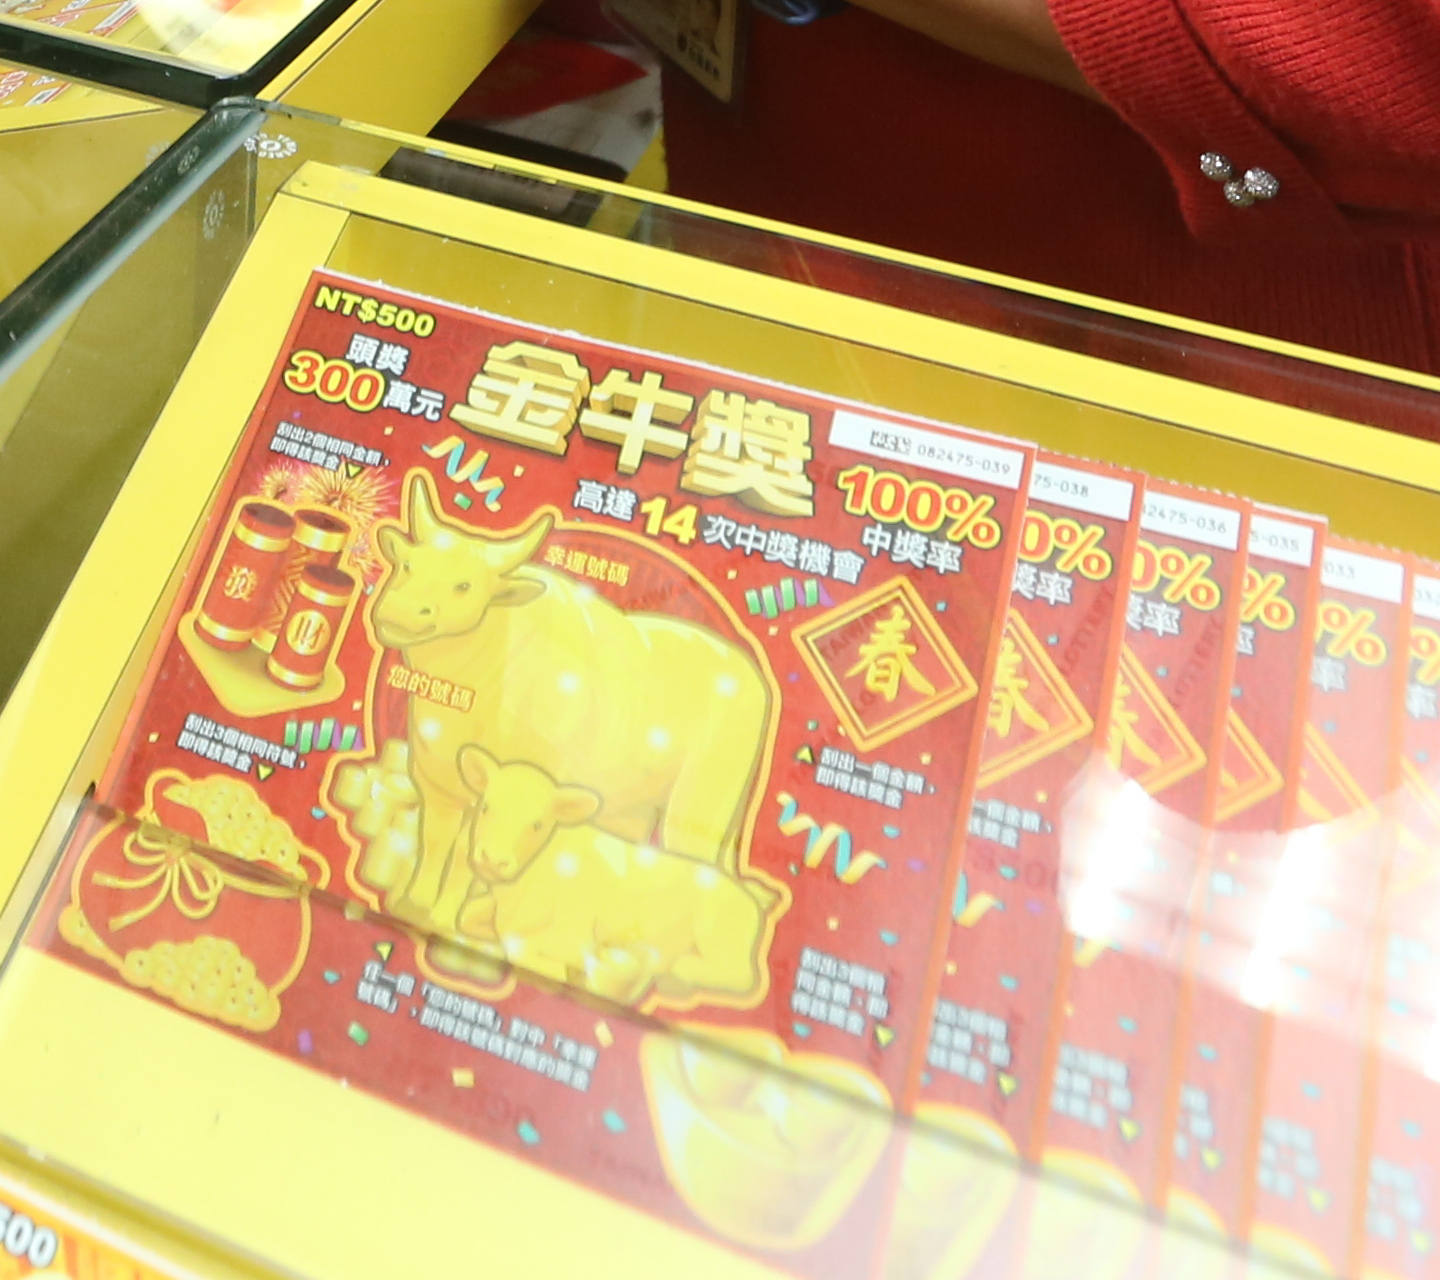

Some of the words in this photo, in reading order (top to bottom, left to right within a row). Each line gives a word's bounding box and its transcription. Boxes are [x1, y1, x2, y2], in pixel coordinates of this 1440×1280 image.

[314, 285, 437, 339] NT$500
[345, 333, 411, 377] 頭獎
[283, 349, 446, 422] 300萬元
[449, 339, 816, 518] 金牛獎
[917, 445, 1011, 476] 082475-039
[838, 463, 1003, 550] 100%
[542, 543, 631, 589] 幸運號碼
[862, 524, 964, 575] 中獎率
[844, 604, 937, 702] 春
[387, 664, 477, 713] 您的號碼
